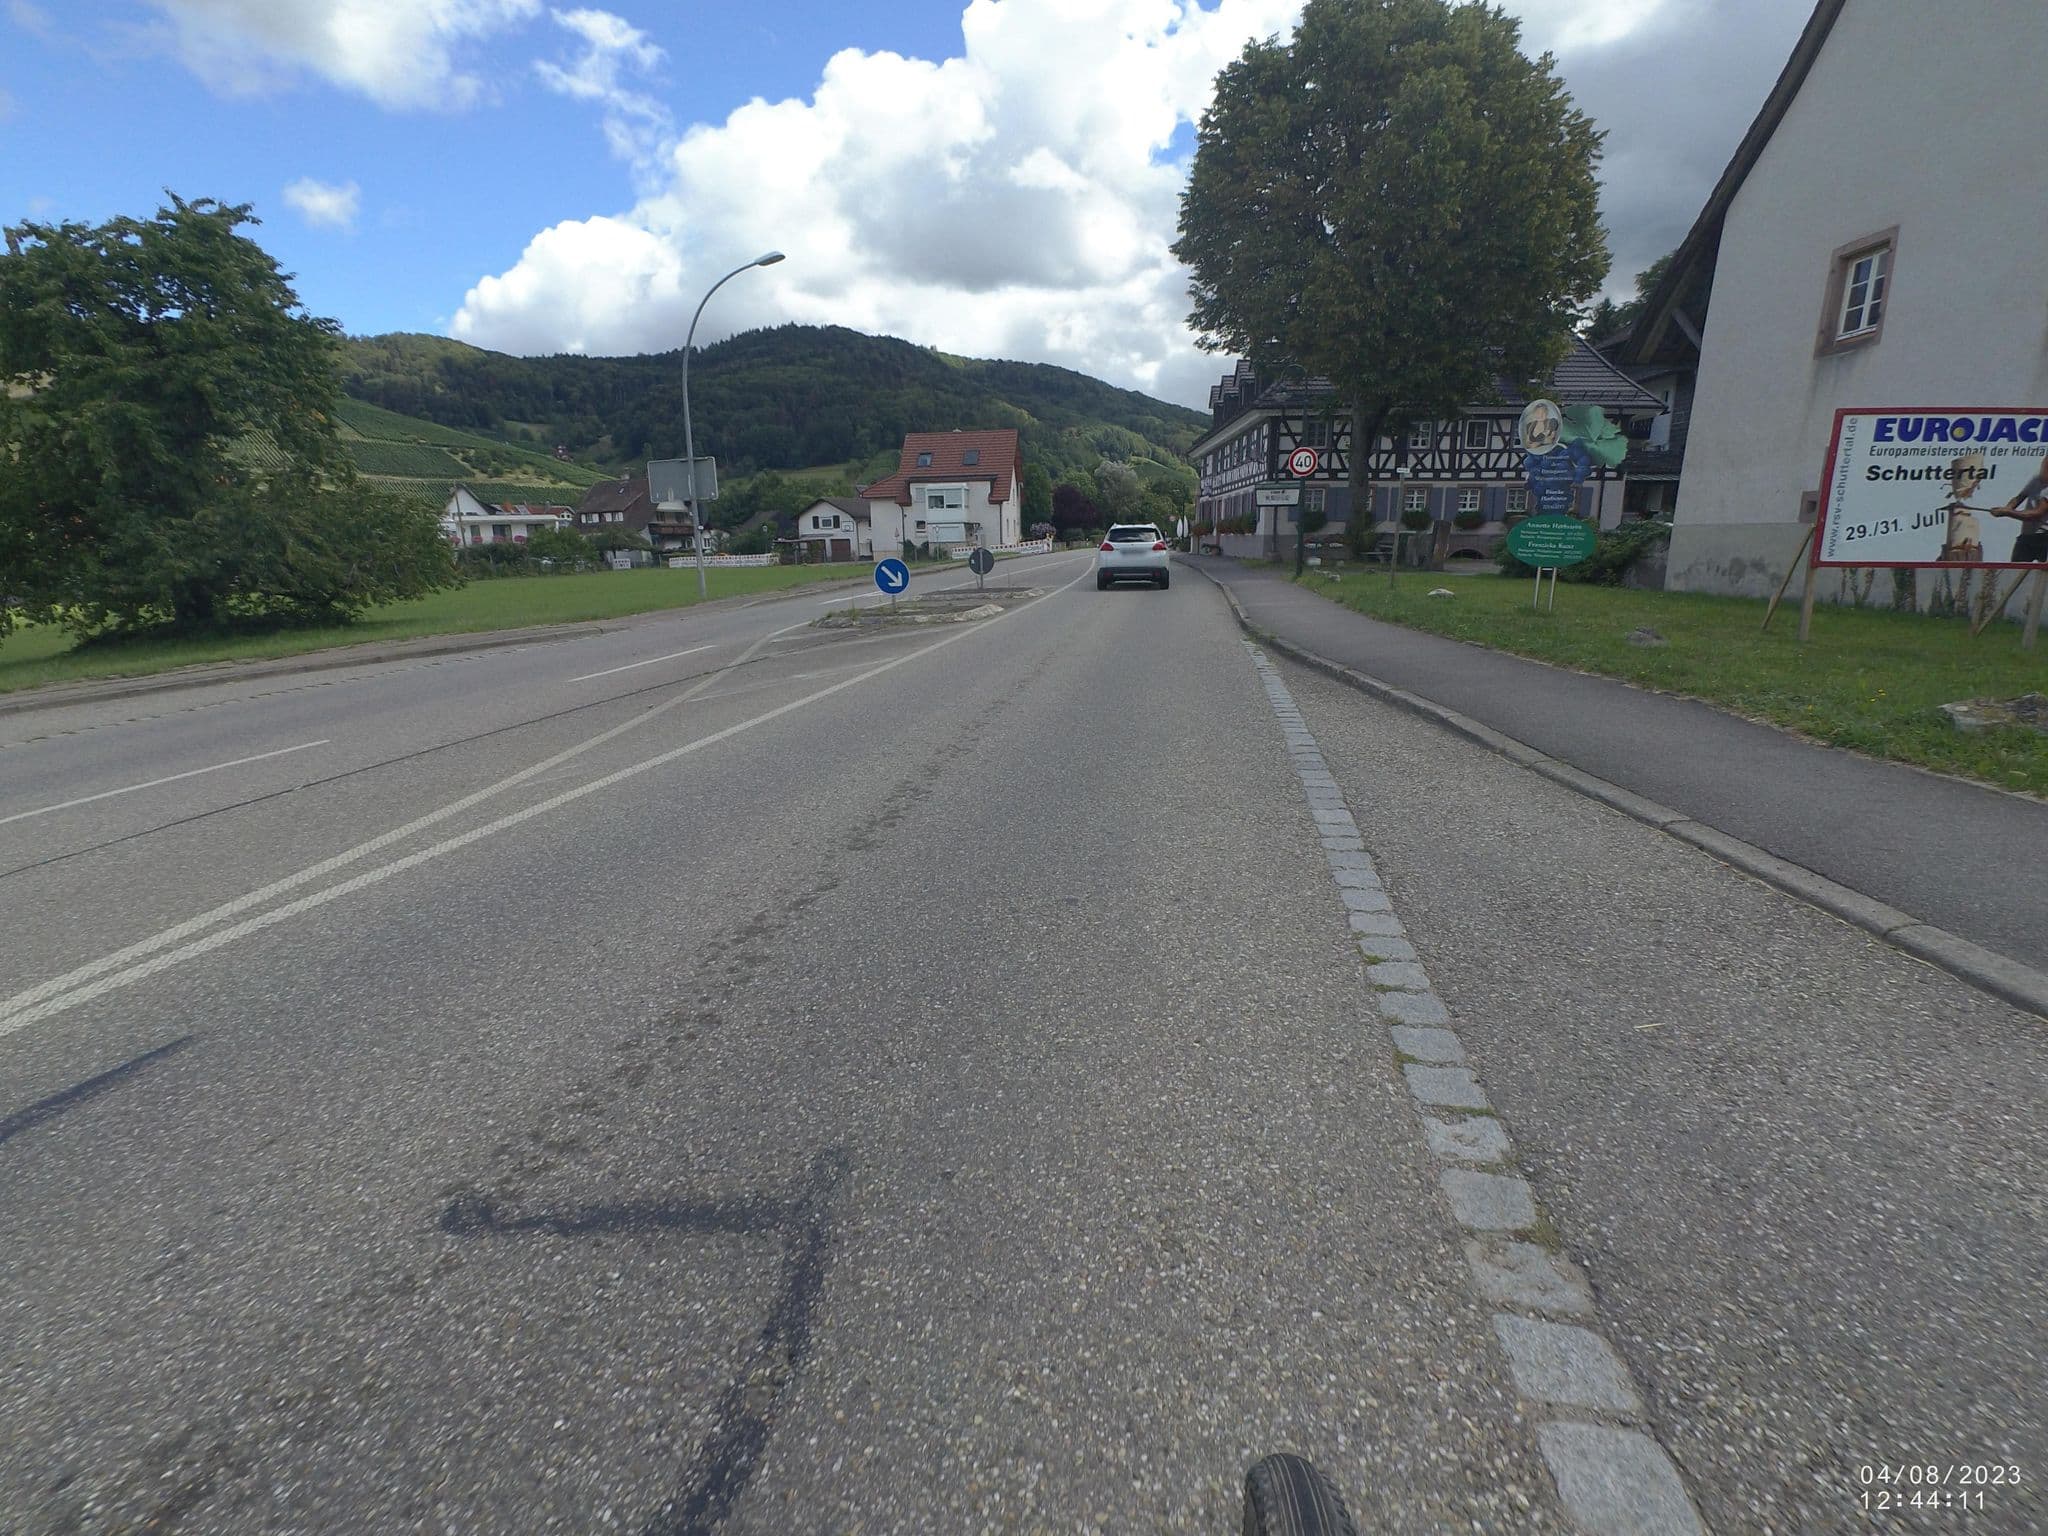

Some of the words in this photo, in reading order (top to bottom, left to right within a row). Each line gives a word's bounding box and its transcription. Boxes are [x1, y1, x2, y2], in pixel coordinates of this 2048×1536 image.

[1869, 445, 1987, 457] Europameisterschaft
[1990, 446, 2009, 457] der
[1295, 455, 1312, 468] 40
[1865, 464, 1997, 481] Schuttertal
[1827, 417, 1858, 558] www.rsv-schuttertal.de
[1845, 518, 1903, 541] 29./31.
[1911, 509, 1945, 530] Juli
